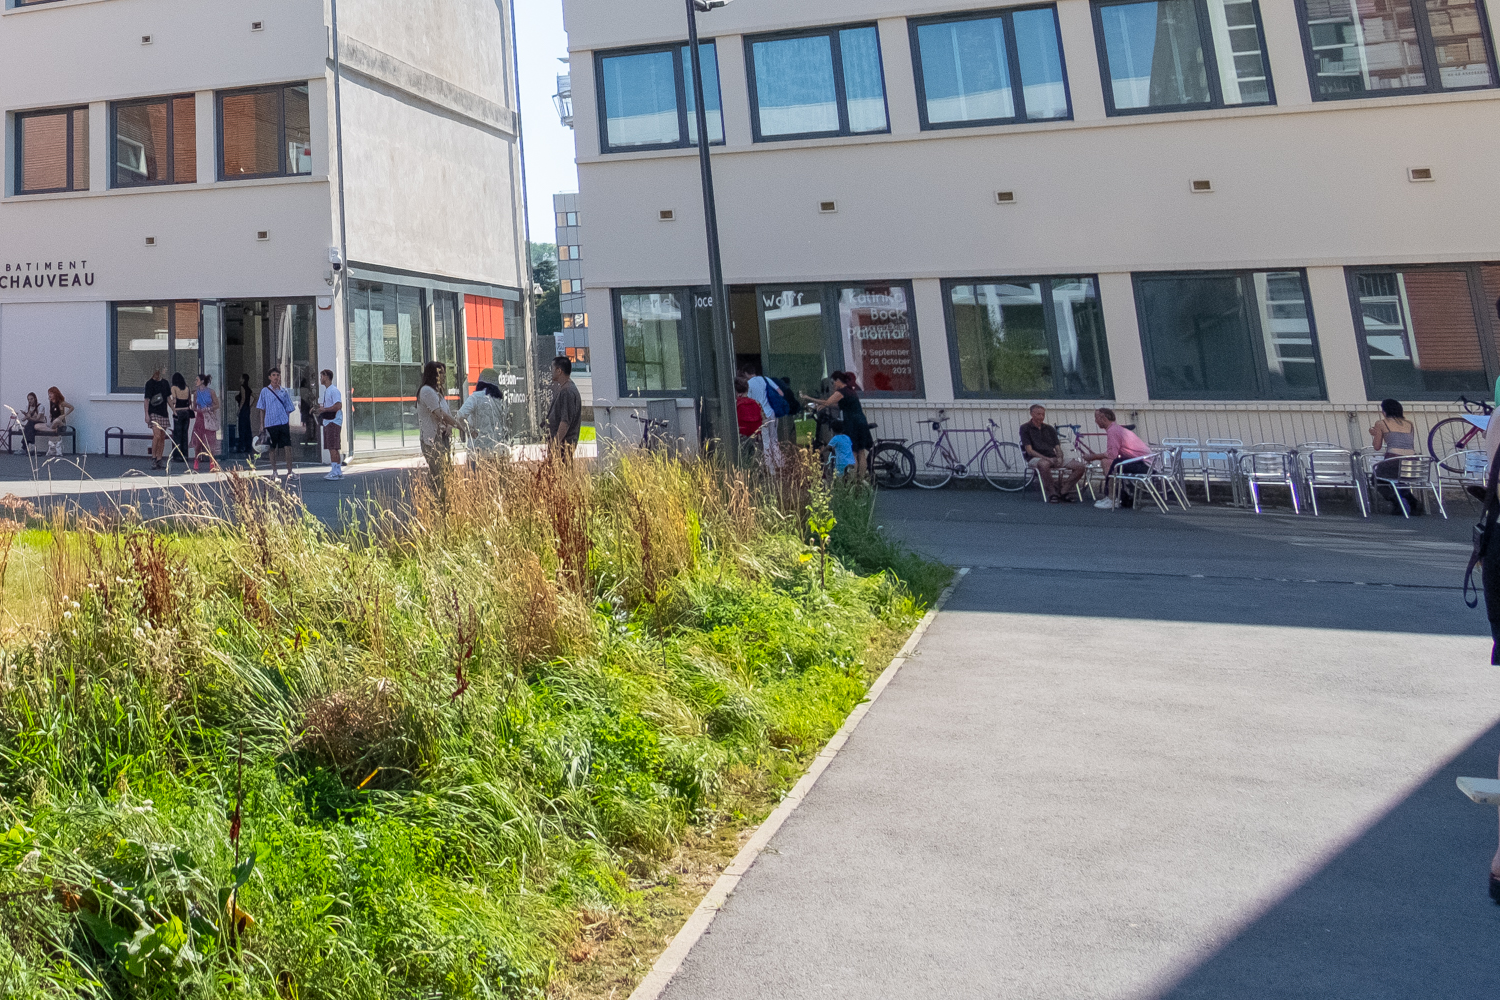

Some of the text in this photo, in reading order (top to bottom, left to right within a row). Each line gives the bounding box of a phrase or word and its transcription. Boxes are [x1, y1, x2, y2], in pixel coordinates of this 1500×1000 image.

[5, 260, 88, 272] BATIMENT
[762, 292, 804, 307] Wolff
[870, 307, 906, 320] Bock
[869, 348, 909, 357] September
[881, 357, 910, 365] October
